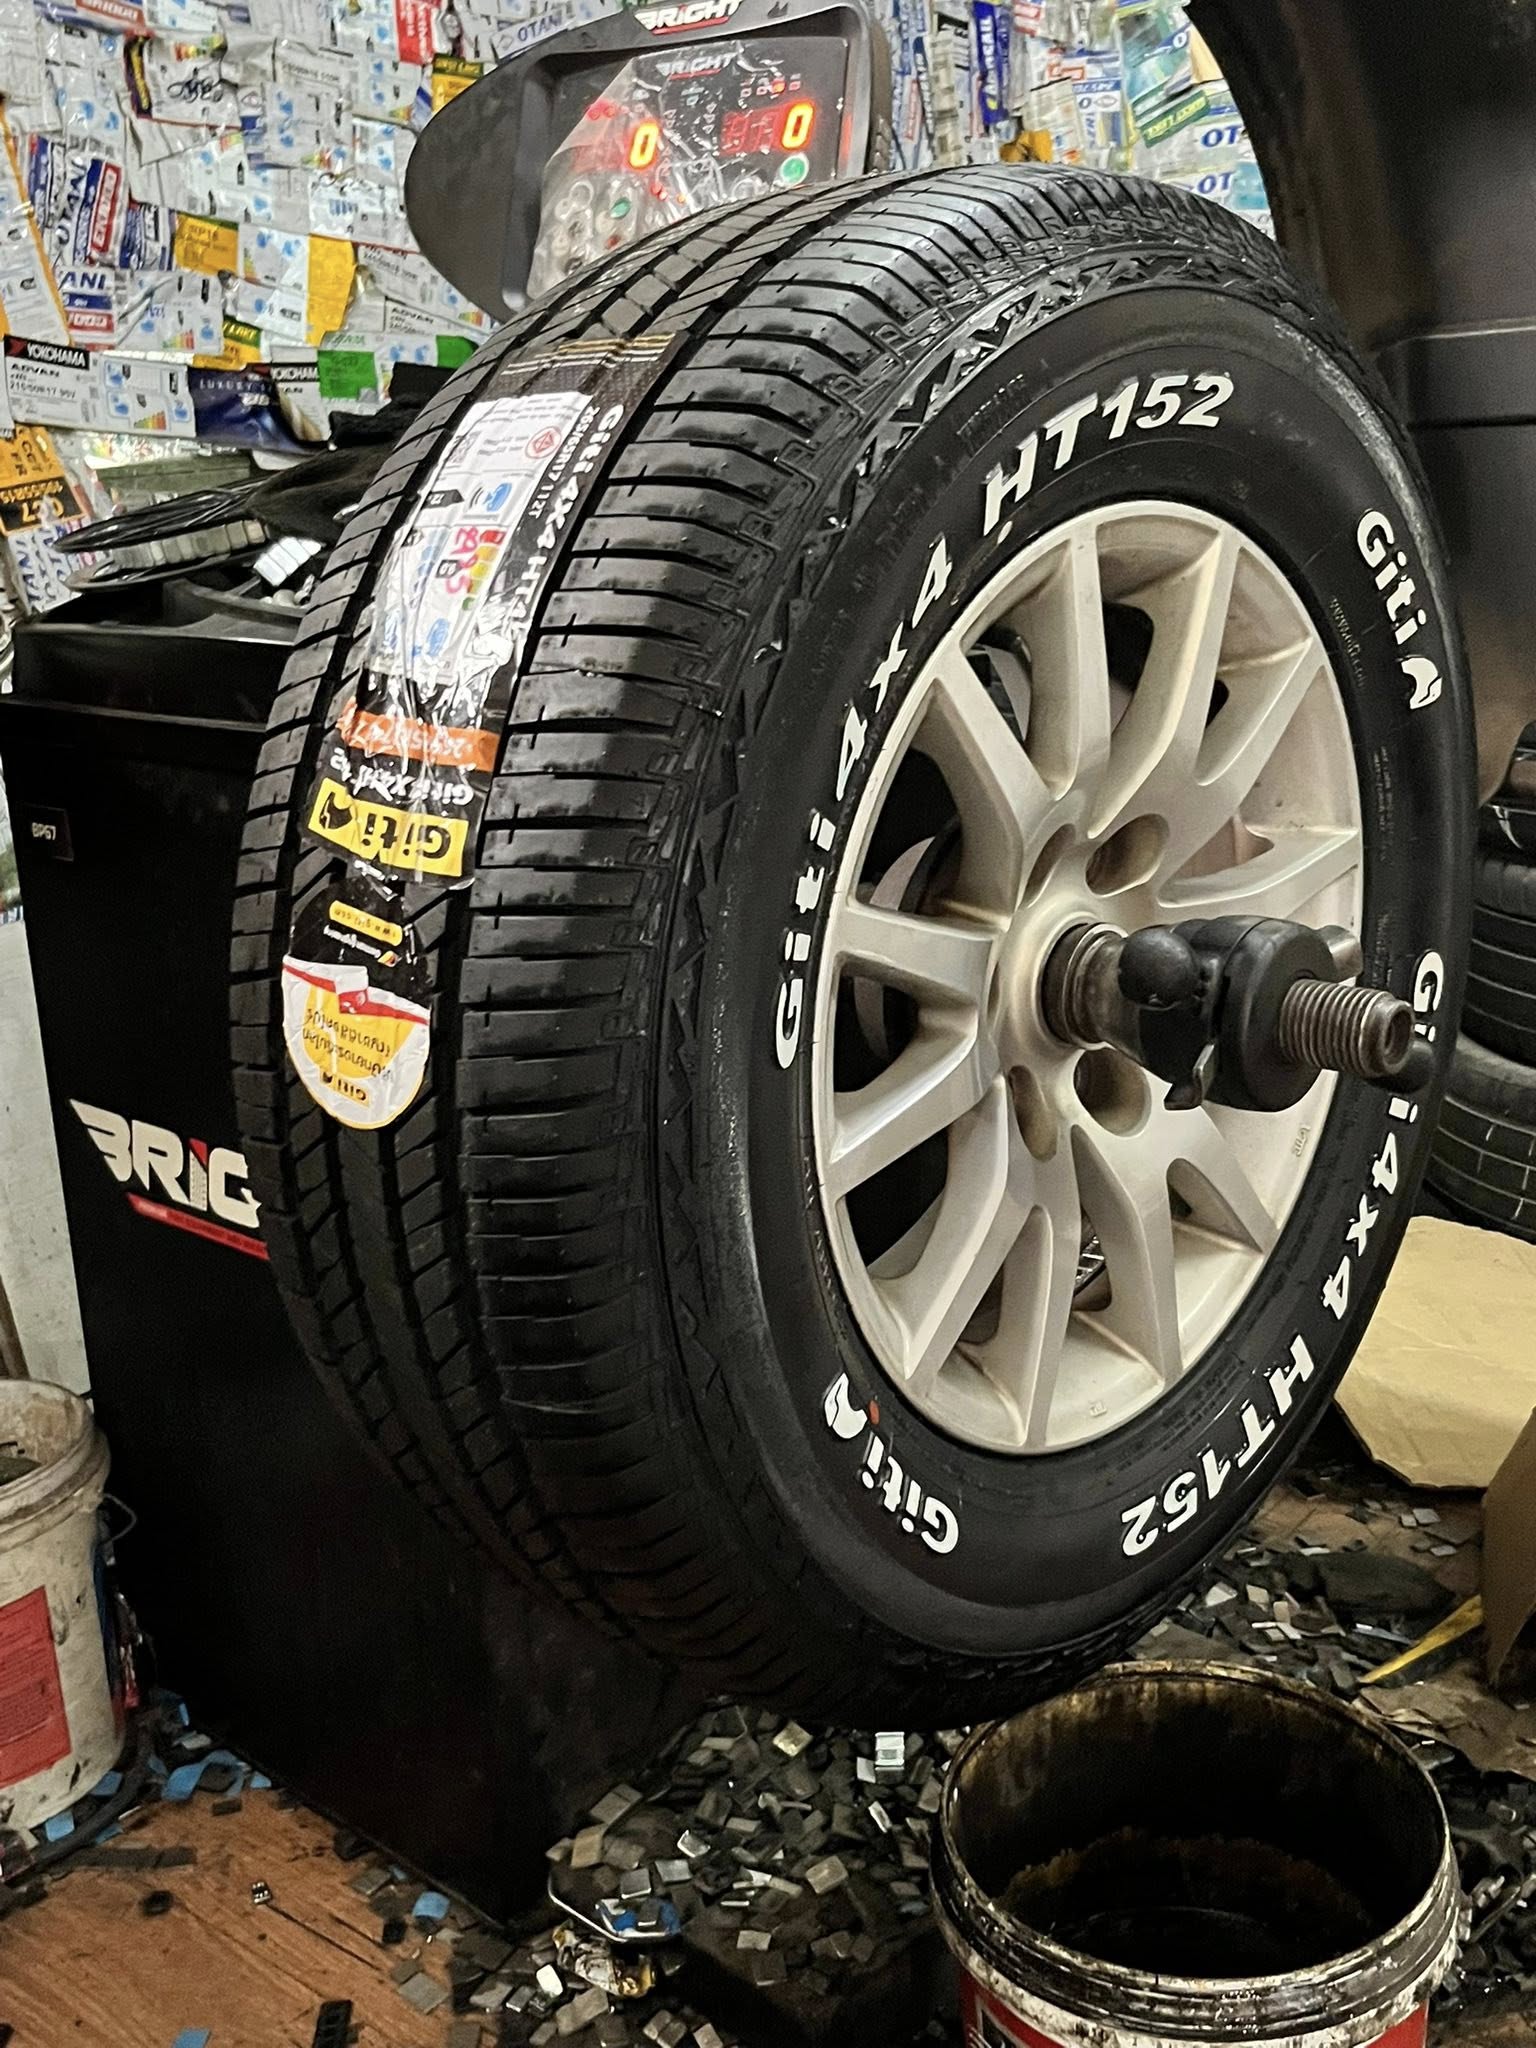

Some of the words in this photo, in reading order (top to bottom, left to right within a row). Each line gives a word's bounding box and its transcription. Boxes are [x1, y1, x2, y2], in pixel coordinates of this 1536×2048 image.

[630, 120, 661, 170] 0
[780, 102, 814, 149] 0
[27, 342, 86, 367] YOKOHAMA
[984, 372, 1235, 536] HT152
[1357, 509, 1428, 645] Giti
[361, 812, 452, 860] Giti
[1121, 1334, 1316, 1557] HT152
[861, 1433, 960, 1555] Giti
